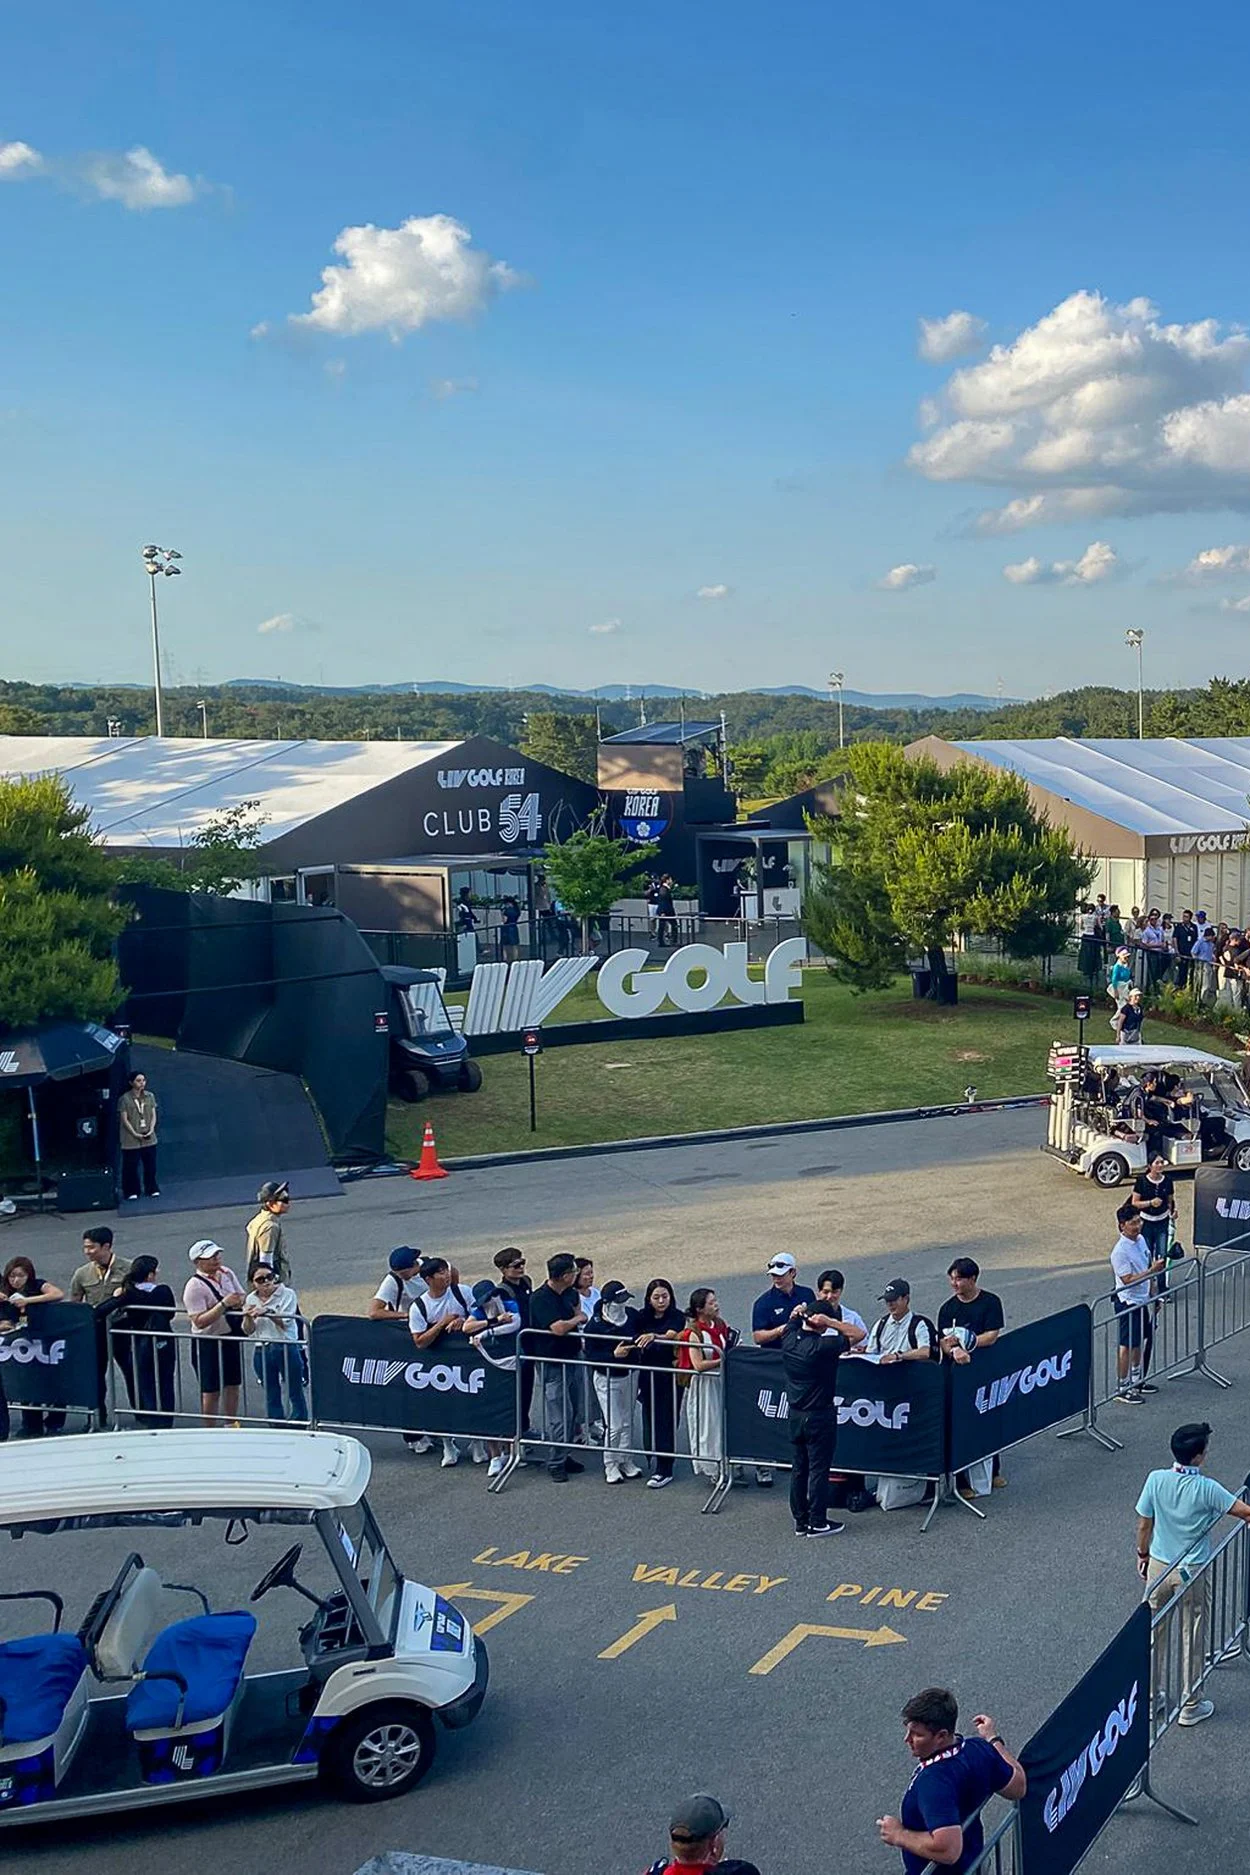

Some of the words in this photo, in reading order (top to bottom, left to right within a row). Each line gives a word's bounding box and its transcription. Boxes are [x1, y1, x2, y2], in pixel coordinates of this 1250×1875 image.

[467, 768, 503, 787] GOLF
[423, 808, 492, 837] CLUB
[498, 793, 542, 843] 54
[623, 795, 660, 818] KOREA
[1197, 833, 1231, 851] GOLF
[597, 937, 807, 1018] GOLF
[342, 1357, 408, 1386] LIV
[404, 1362, 485, 1394] GOLF
[975, 1370, 1021, 1414] LIV
[1018, 1349, 1073, 1395] GOLF
[471, 1546, 590, 1575] LAKE
[631, 1563, 788, 1594] VALLEY
[826, 1583, 950, 1612] PINE
[1044, 1744, 1091, 1834] LIV
[1088, 1680, 1139, 1777] GOLF
